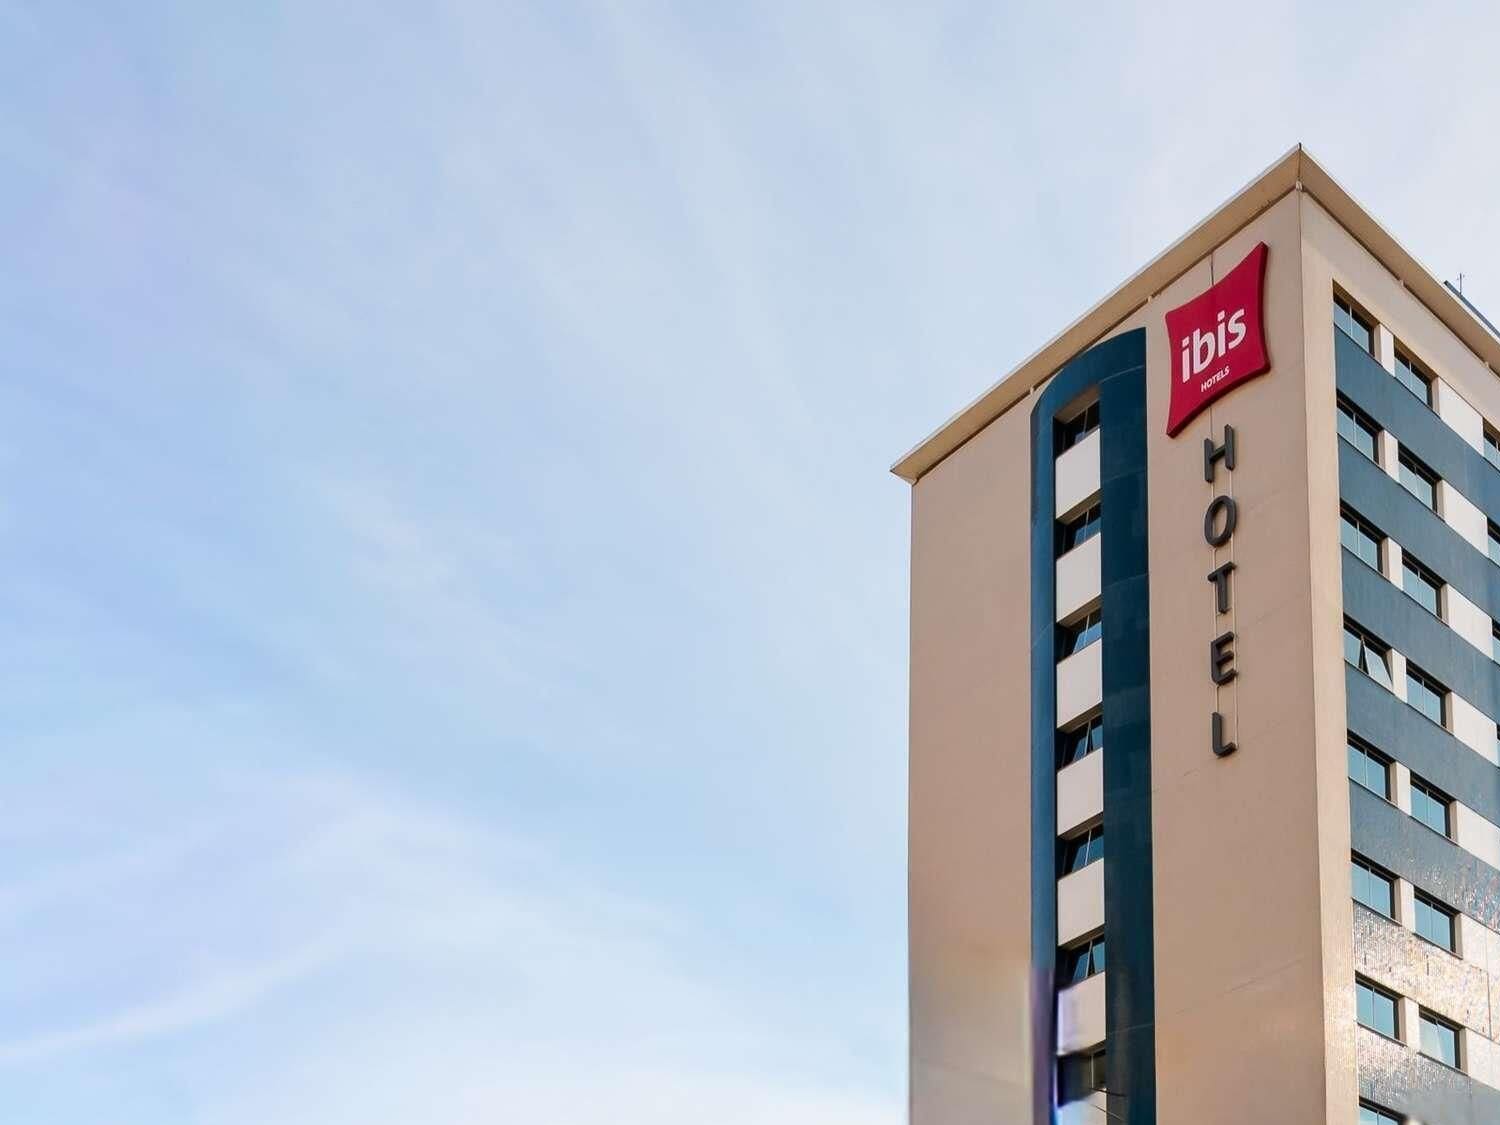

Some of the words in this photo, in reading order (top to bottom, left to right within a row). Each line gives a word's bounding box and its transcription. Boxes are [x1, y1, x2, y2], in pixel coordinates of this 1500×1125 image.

[1181, 308, 1248, 383] ibis
[1200, 365, 1230, 392] HOTELS
[1204, 424, 1239, 757] HOTEL
